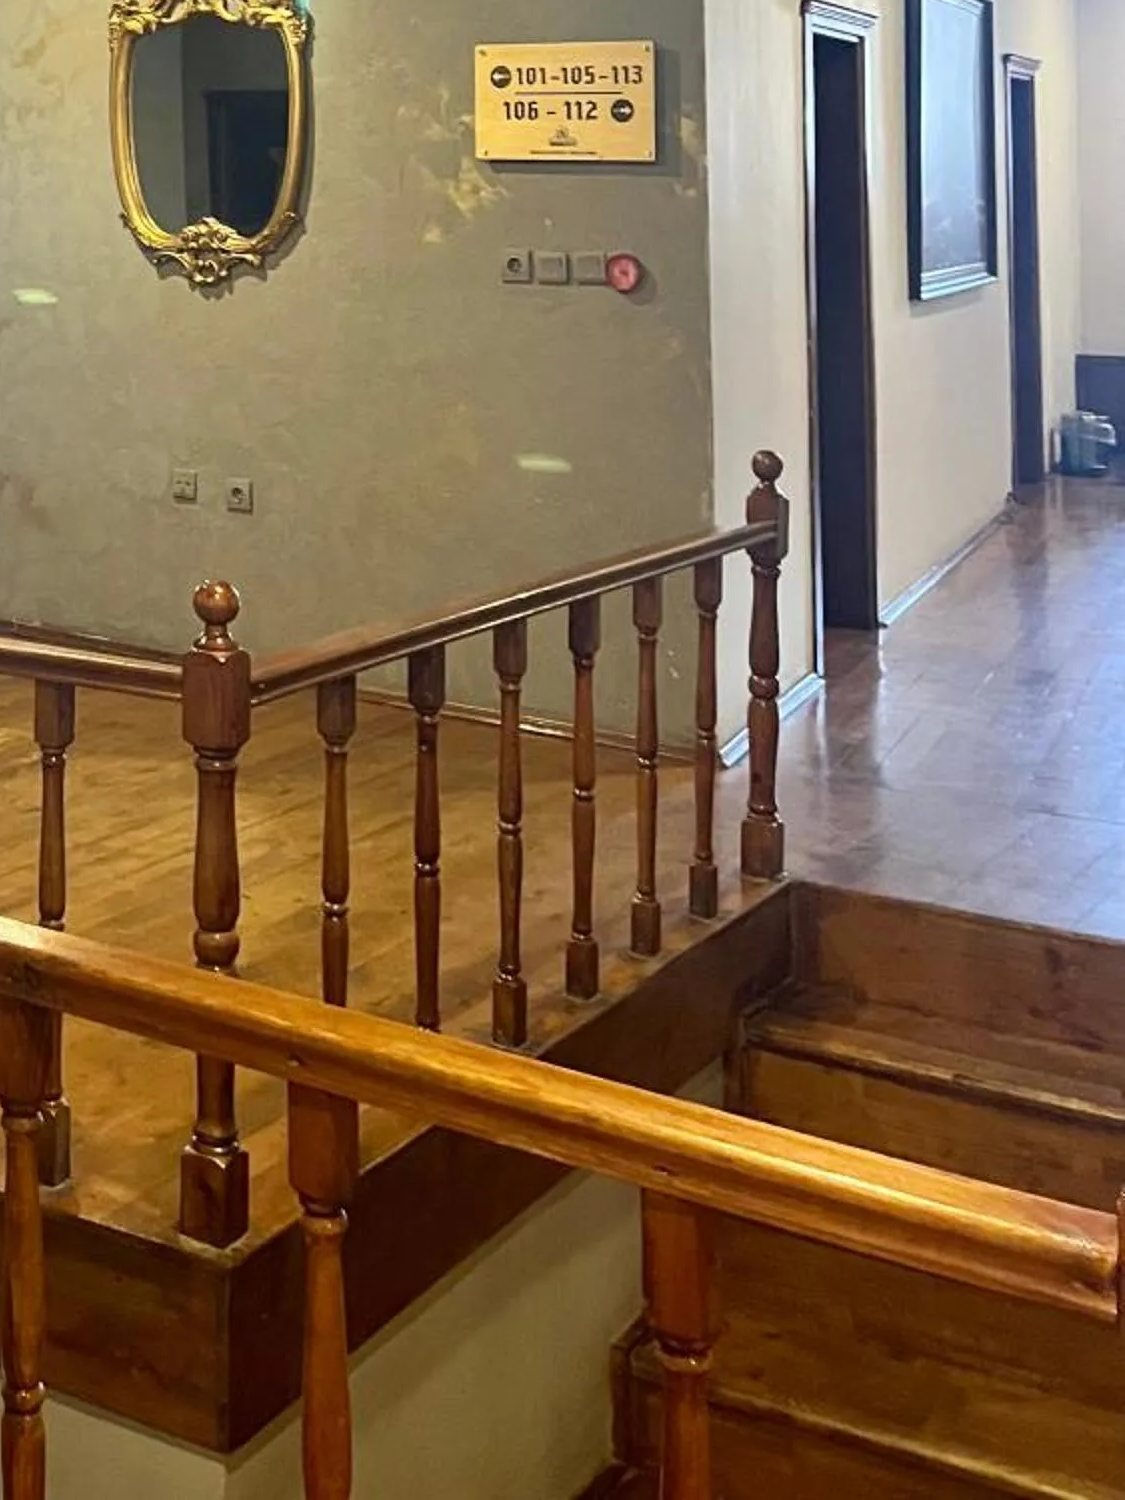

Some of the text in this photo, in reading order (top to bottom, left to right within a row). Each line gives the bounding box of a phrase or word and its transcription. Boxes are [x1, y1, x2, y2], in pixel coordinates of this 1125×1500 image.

[516, 65, 643, 85] 101-105-113
[503, 101, 539, 121] 106
[563, 100, 598, 121] 112
